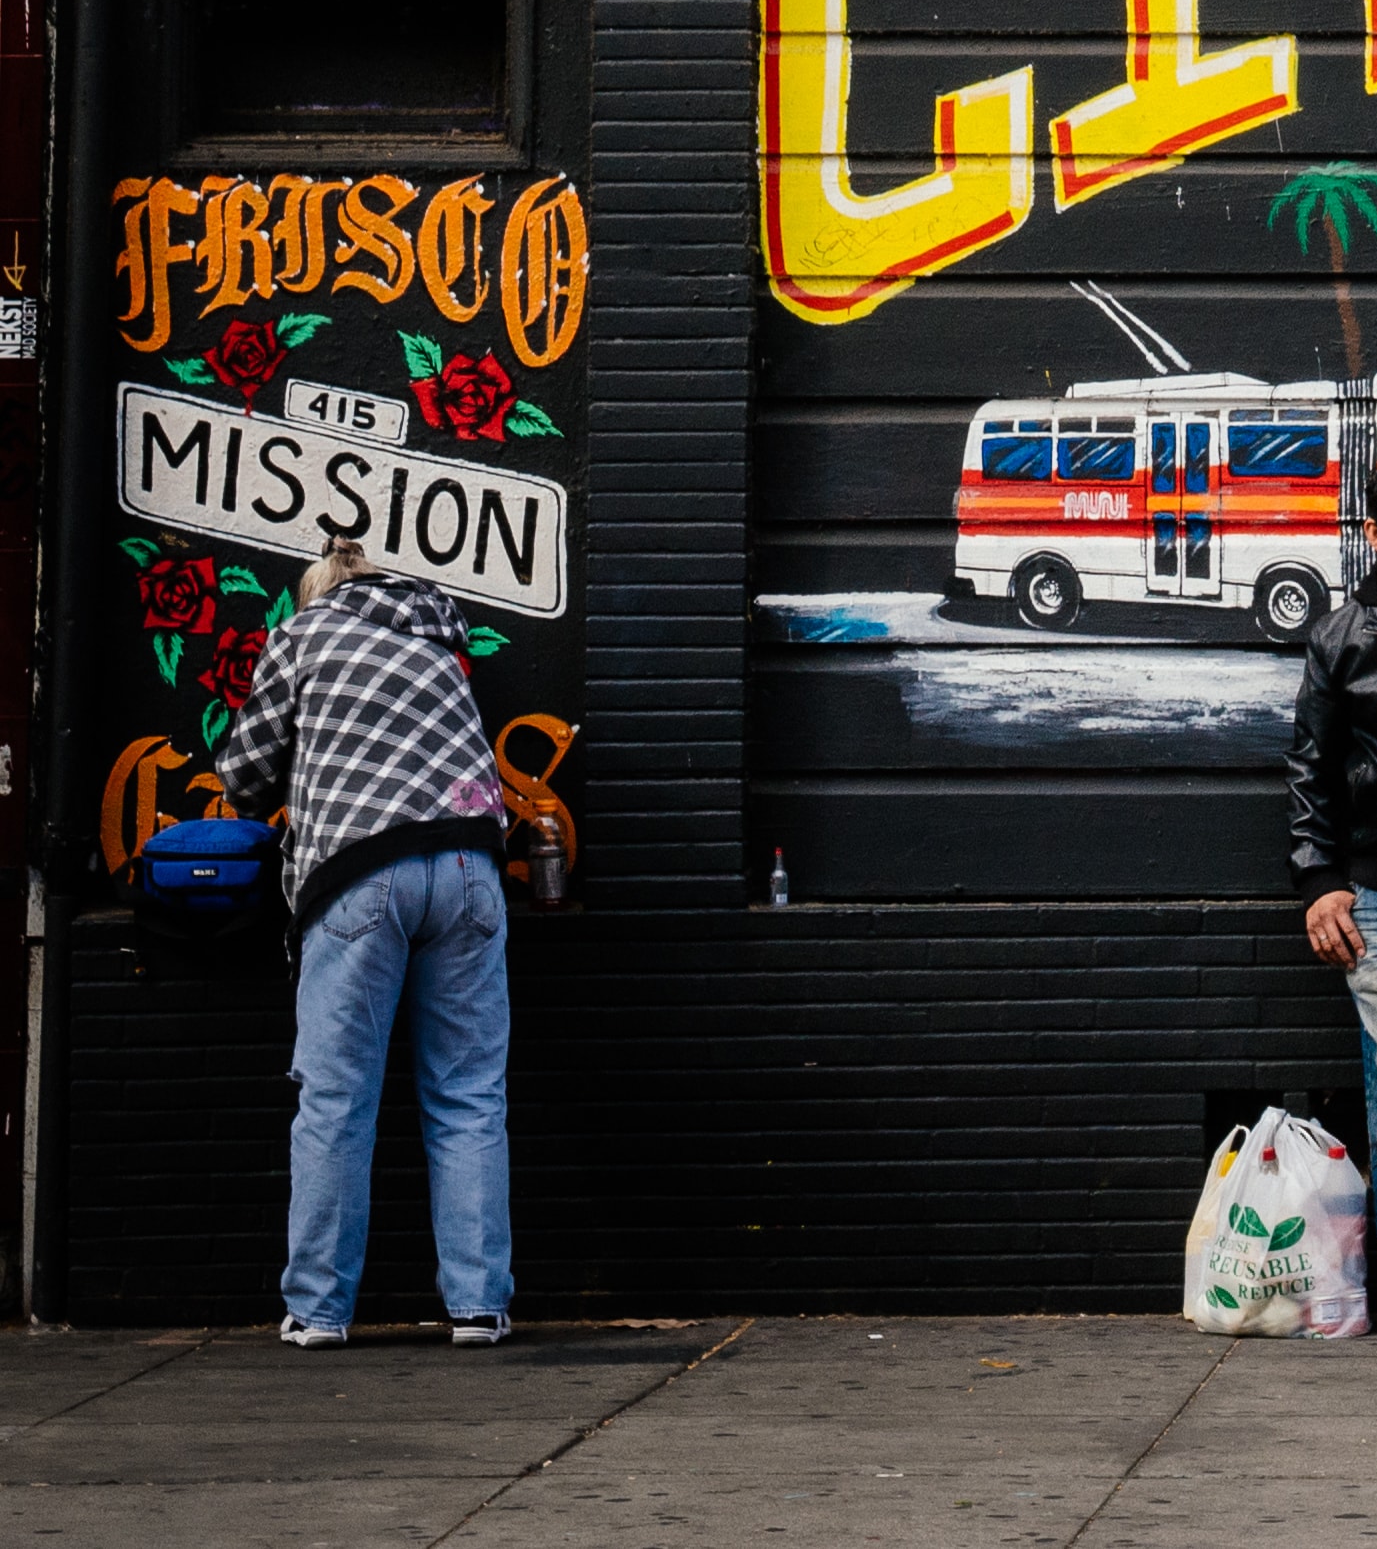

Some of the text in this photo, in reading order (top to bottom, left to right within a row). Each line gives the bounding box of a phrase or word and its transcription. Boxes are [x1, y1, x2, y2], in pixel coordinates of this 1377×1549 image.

[111, 173, 590, 368] FRISCO
[0, 296, 22, 359] NEKST
[308, 392, 376, 430] 415
[140, 412, 540, 586] MISSION
[1209, 1252, 1313, 1281] REUSABLE
[1238, 1275, 1316, 1300] REDUCE
